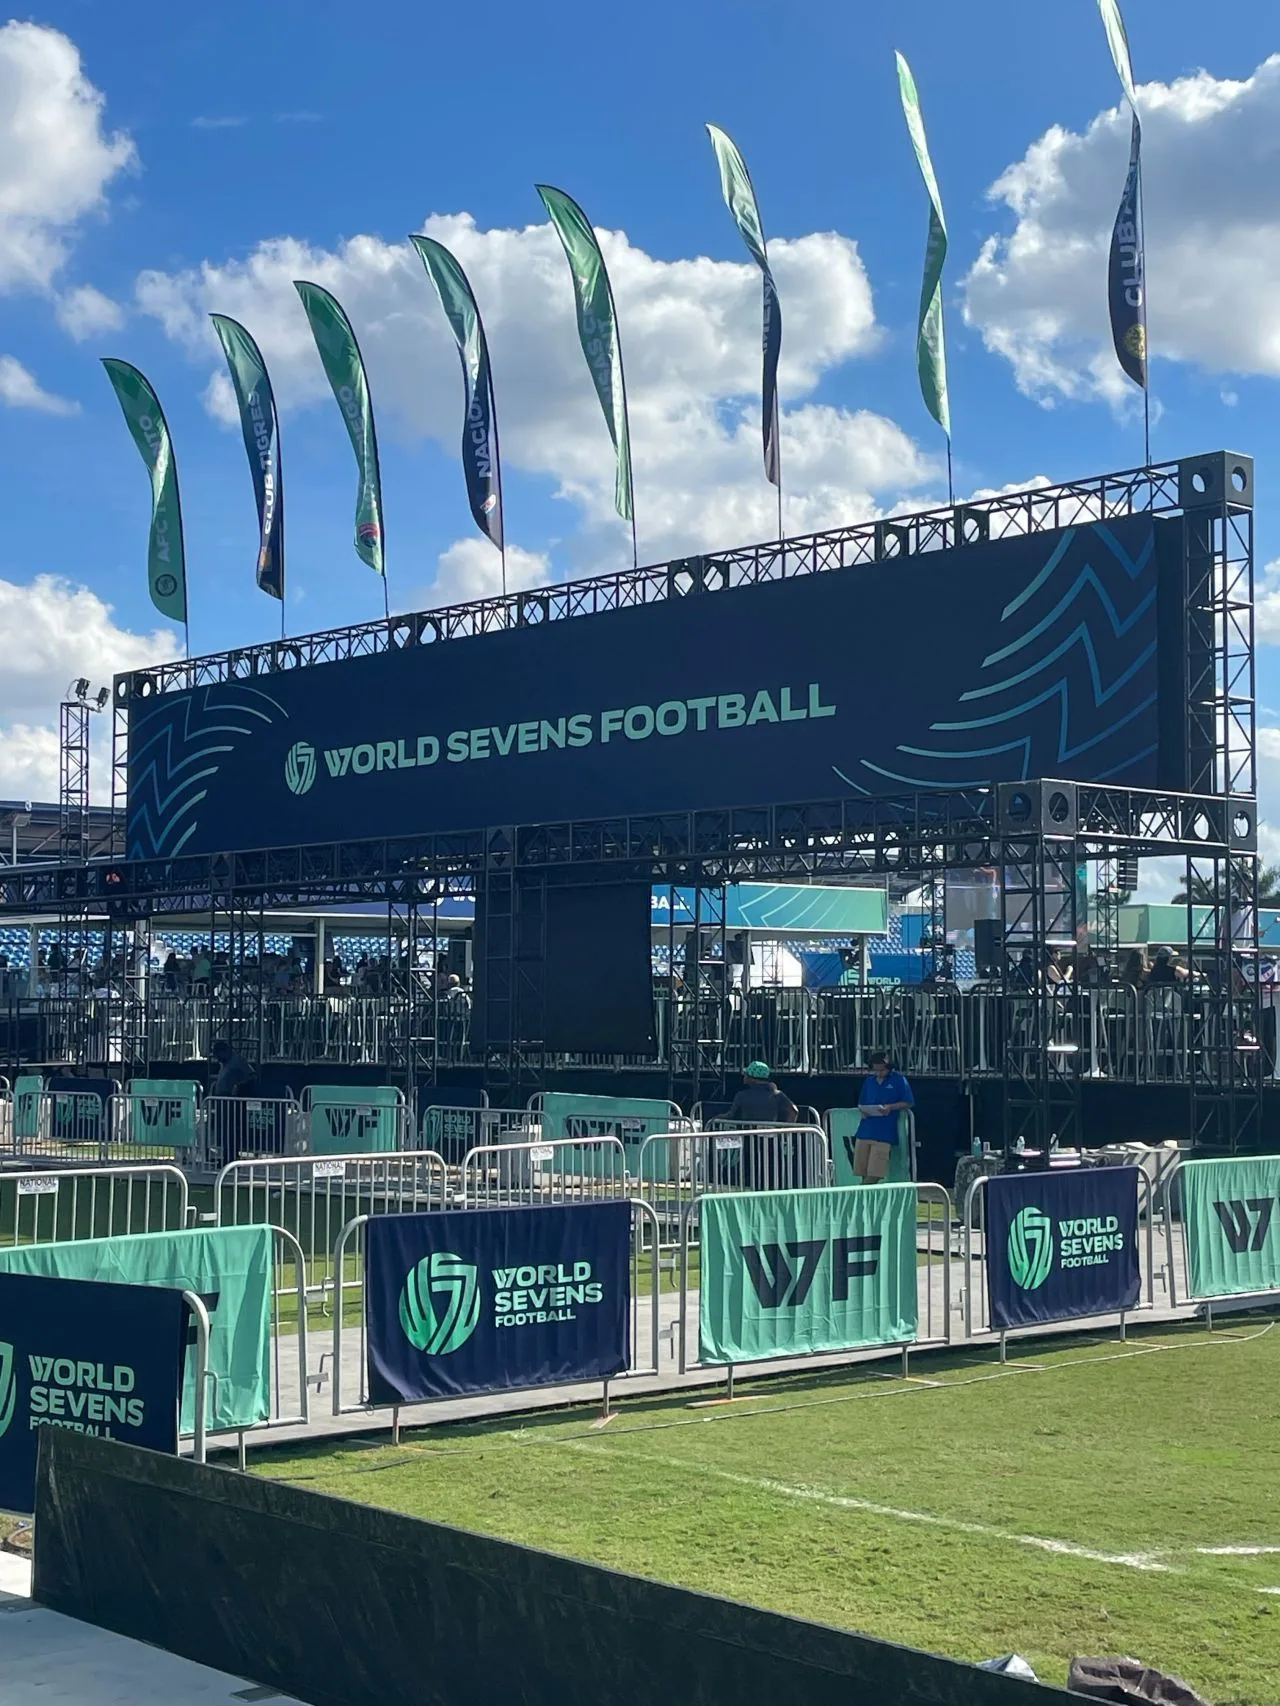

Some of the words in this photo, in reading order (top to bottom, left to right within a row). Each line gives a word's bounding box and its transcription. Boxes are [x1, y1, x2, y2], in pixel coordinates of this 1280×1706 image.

[1117, 221, 1143, 308] CLUB
[249, 391, 272, 471] TIGRES
[467, 350, 492, 478] NACIOAL
[263, 474, 275, 535] CLUB
[155, 519, 171, 563] AFC
[324, 735, 440, 777] WORLD
[447, 714, 593, 762] SEVENS
[601, 683, 836, 743] FOOTBALL
[867, 976, 901, 985] WORLD
[20, 1176, 56, 1187] NATIONAL
[1058, 1215, 1118, 1238] WORLD
[1060, 1233, 1124, 1257] SEVENS
[1061, 1253, 1109, 1269] FOOTBALL
[492, 1261, 592, 1289] WORLD
[494, 1282, 603, 1313] SEVENS
[495, 1308, 576, 1328] FOOTBALL
[28, 1354, 135, 1393] WORLD
[30, 1385, 145, 1427] SEVENS
